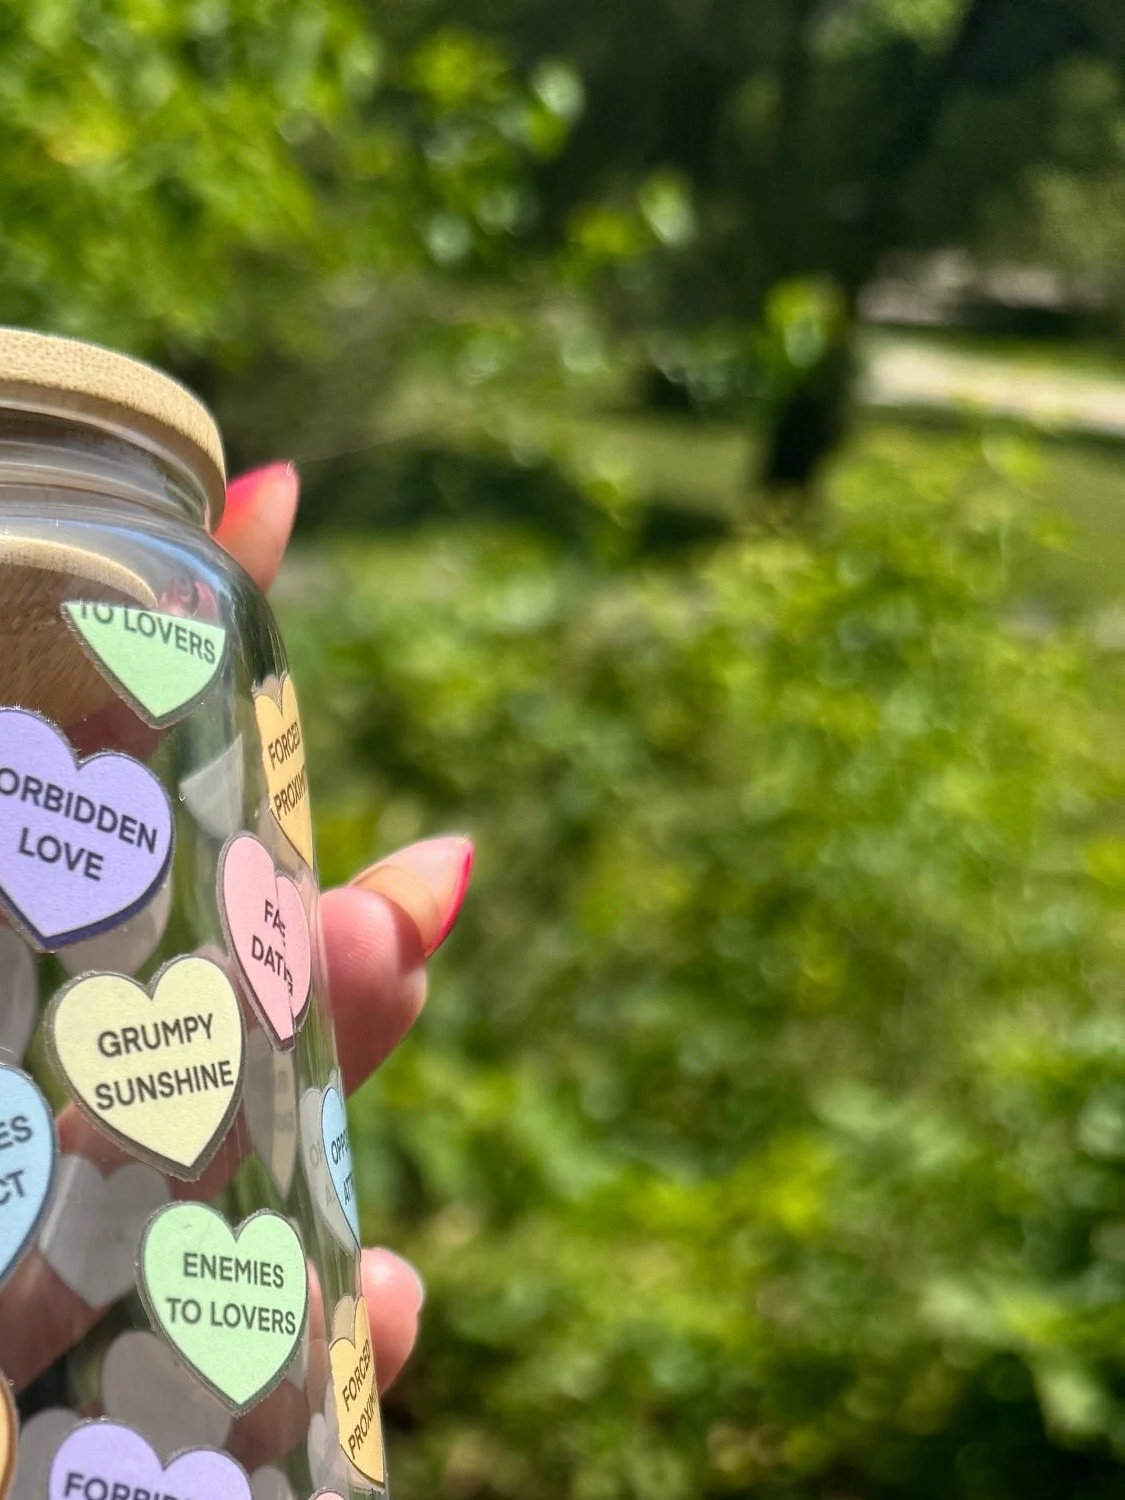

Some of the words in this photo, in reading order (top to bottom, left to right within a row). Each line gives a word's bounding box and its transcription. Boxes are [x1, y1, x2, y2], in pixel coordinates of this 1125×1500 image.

[123, 605, 216, 665] LOVERS
[18, 827, 104, 881] LOVE
[98, 1013, 214, 1058] GRUMPY
[95, 1060, 234, 1111] SUNSHINE
[183, 1253, 284, 1289] ENEMIES
[166, 1298, 202, 1325] TO
[210, 1303, 296, 1334] LOVERS
[342, 1338, 370, 1412] FORCED
